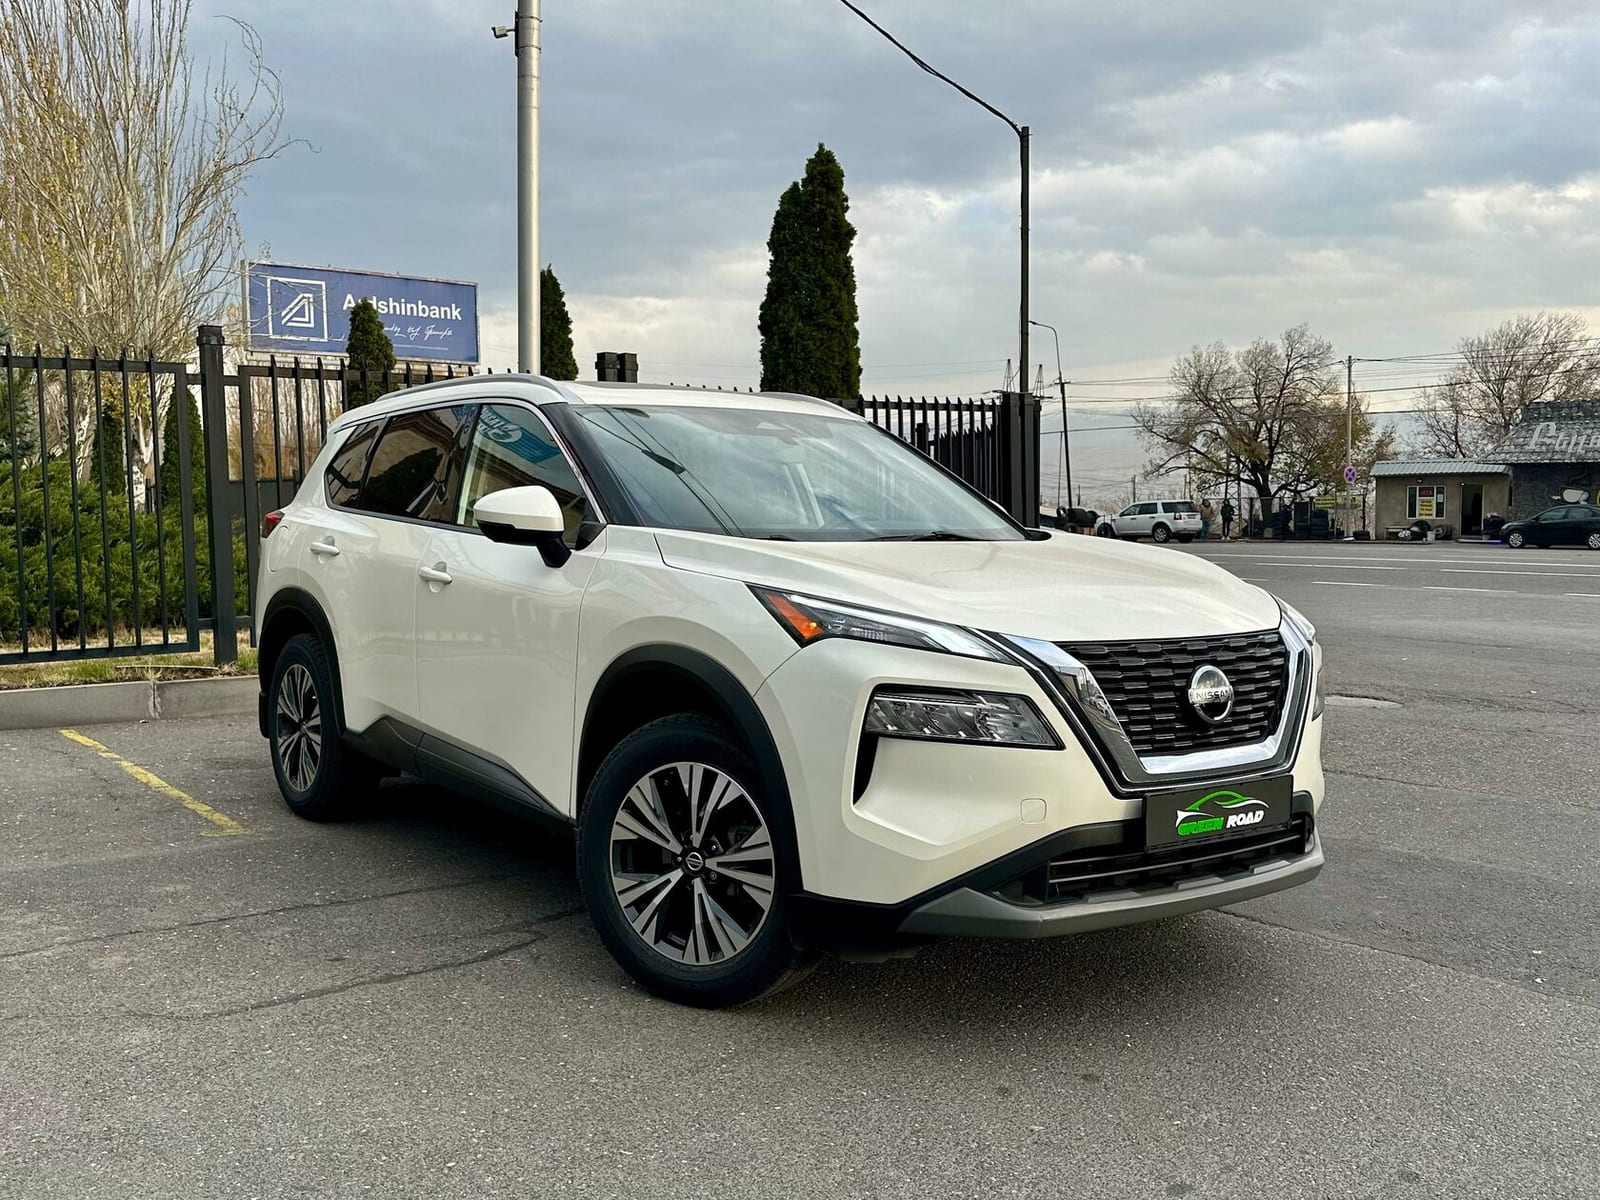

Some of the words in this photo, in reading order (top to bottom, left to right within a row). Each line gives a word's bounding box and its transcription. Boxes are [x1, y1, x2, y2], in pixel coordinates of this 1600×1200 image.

[342, 293, 462, 321] Adshinbank
[1195, 689, 1231, 700] NISSAN
[1177, 817, 1224, 836] GREEN
[1226, 810, 1264, 828] ROAD
